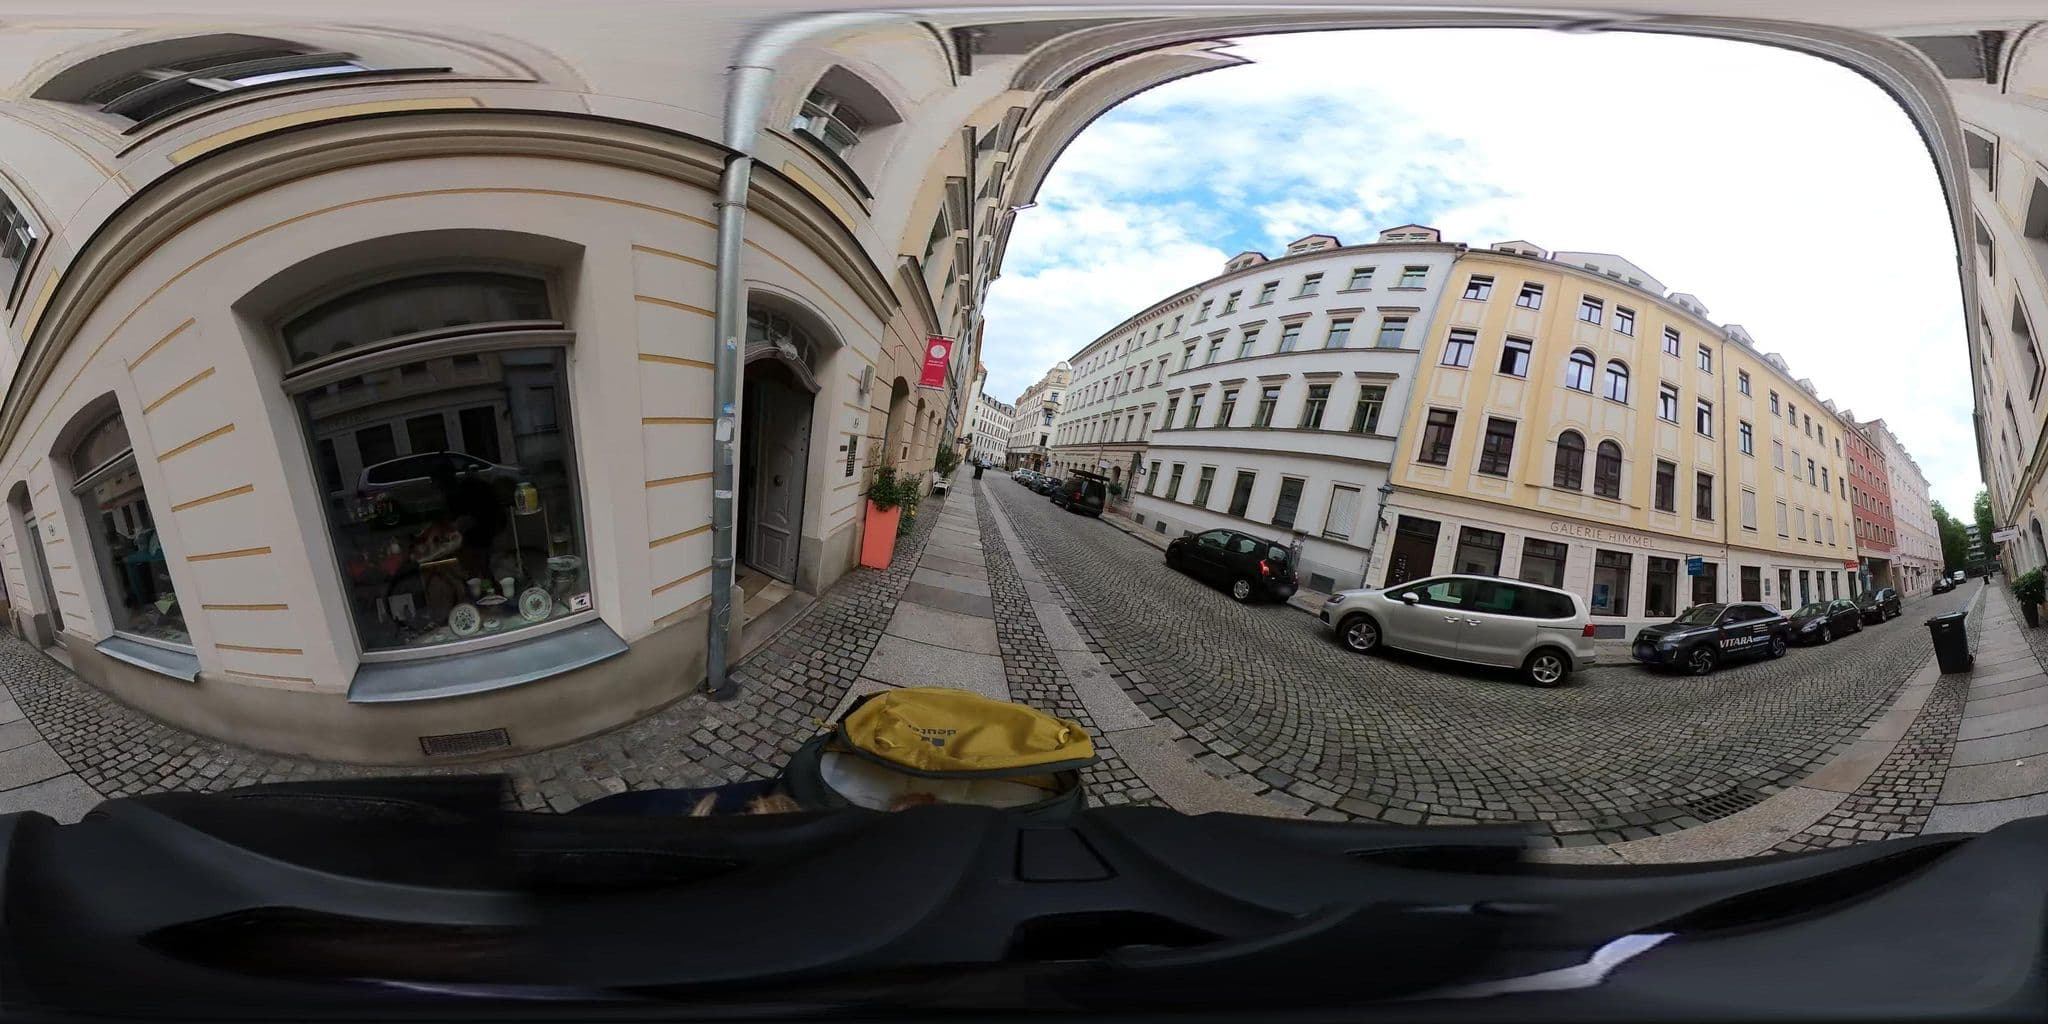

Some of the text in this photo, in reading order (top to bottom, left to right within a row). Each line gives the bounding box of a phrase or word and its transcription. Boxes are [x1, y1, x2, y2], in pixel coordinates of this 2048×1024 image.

[1550, 521, 1655, 548] GALERIE HIMMEL
[1719, 635, 1753, 649] VITARA
